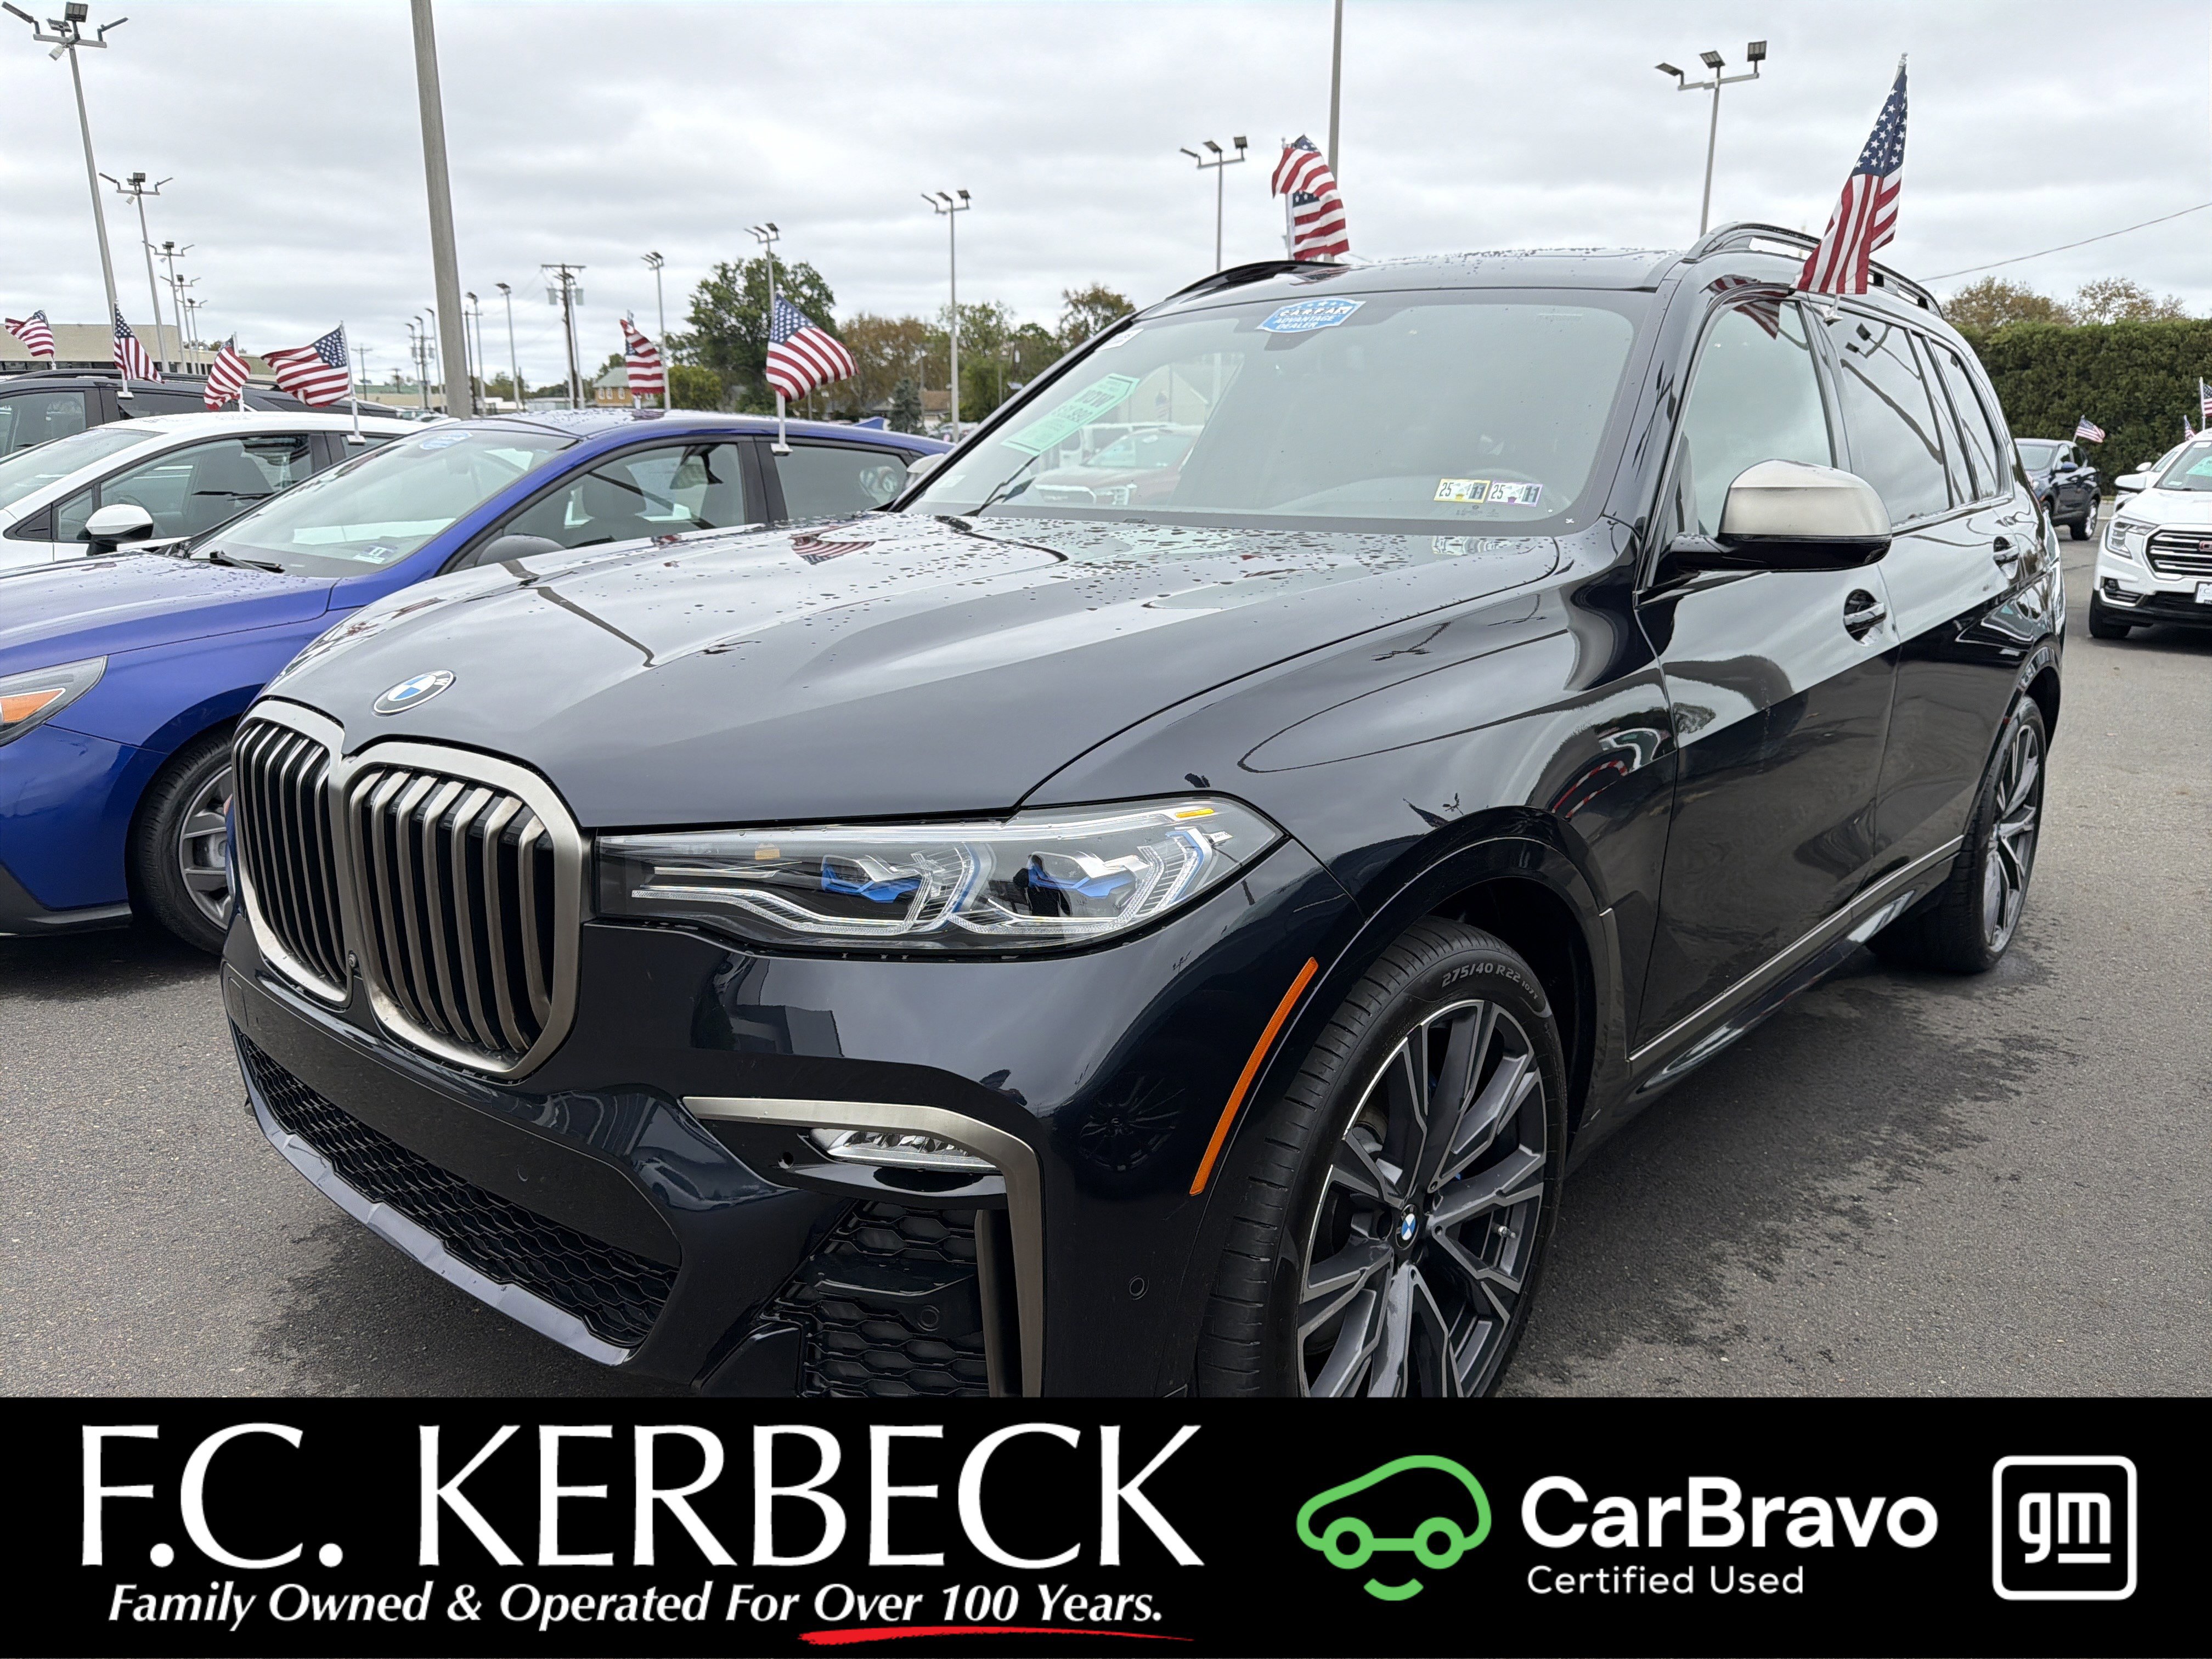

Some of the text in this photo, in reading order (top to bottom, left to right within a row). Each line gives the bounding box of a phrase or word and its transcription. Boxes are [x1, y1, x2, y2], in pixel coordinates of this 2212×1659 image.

[1273, 314, 1335, 325] ADVANTAGE
[1438, 482, 1454, 497] 25
[1490, 484, 1541, 503] 25 11
[1441, 962, 1494, 988] 275/40
[1496, 964, 1521, 983] R22
